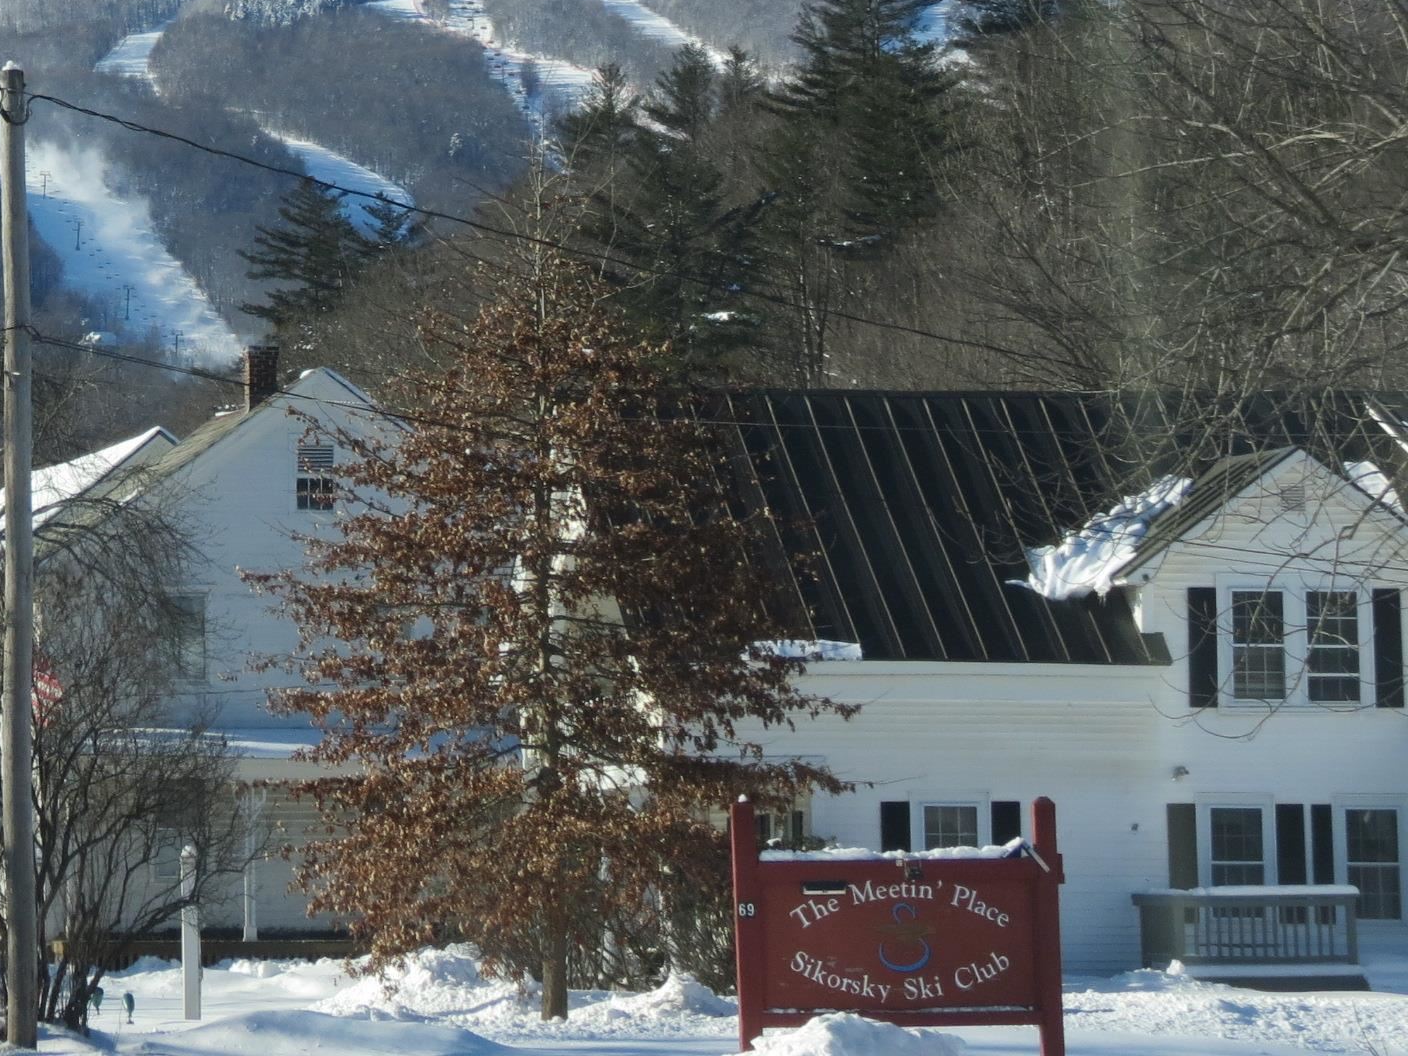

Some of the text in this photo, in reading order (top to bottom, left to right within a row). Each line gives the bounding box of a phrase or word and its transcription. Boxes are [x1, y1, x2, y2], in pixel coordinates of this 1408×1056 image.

[738, 903, 755, 917] 69
[789, 897, 840, 929] The
[950, 884, 1009, 928] Place
[790, 950, 1010, 1004] Sikorsky Ski Club
